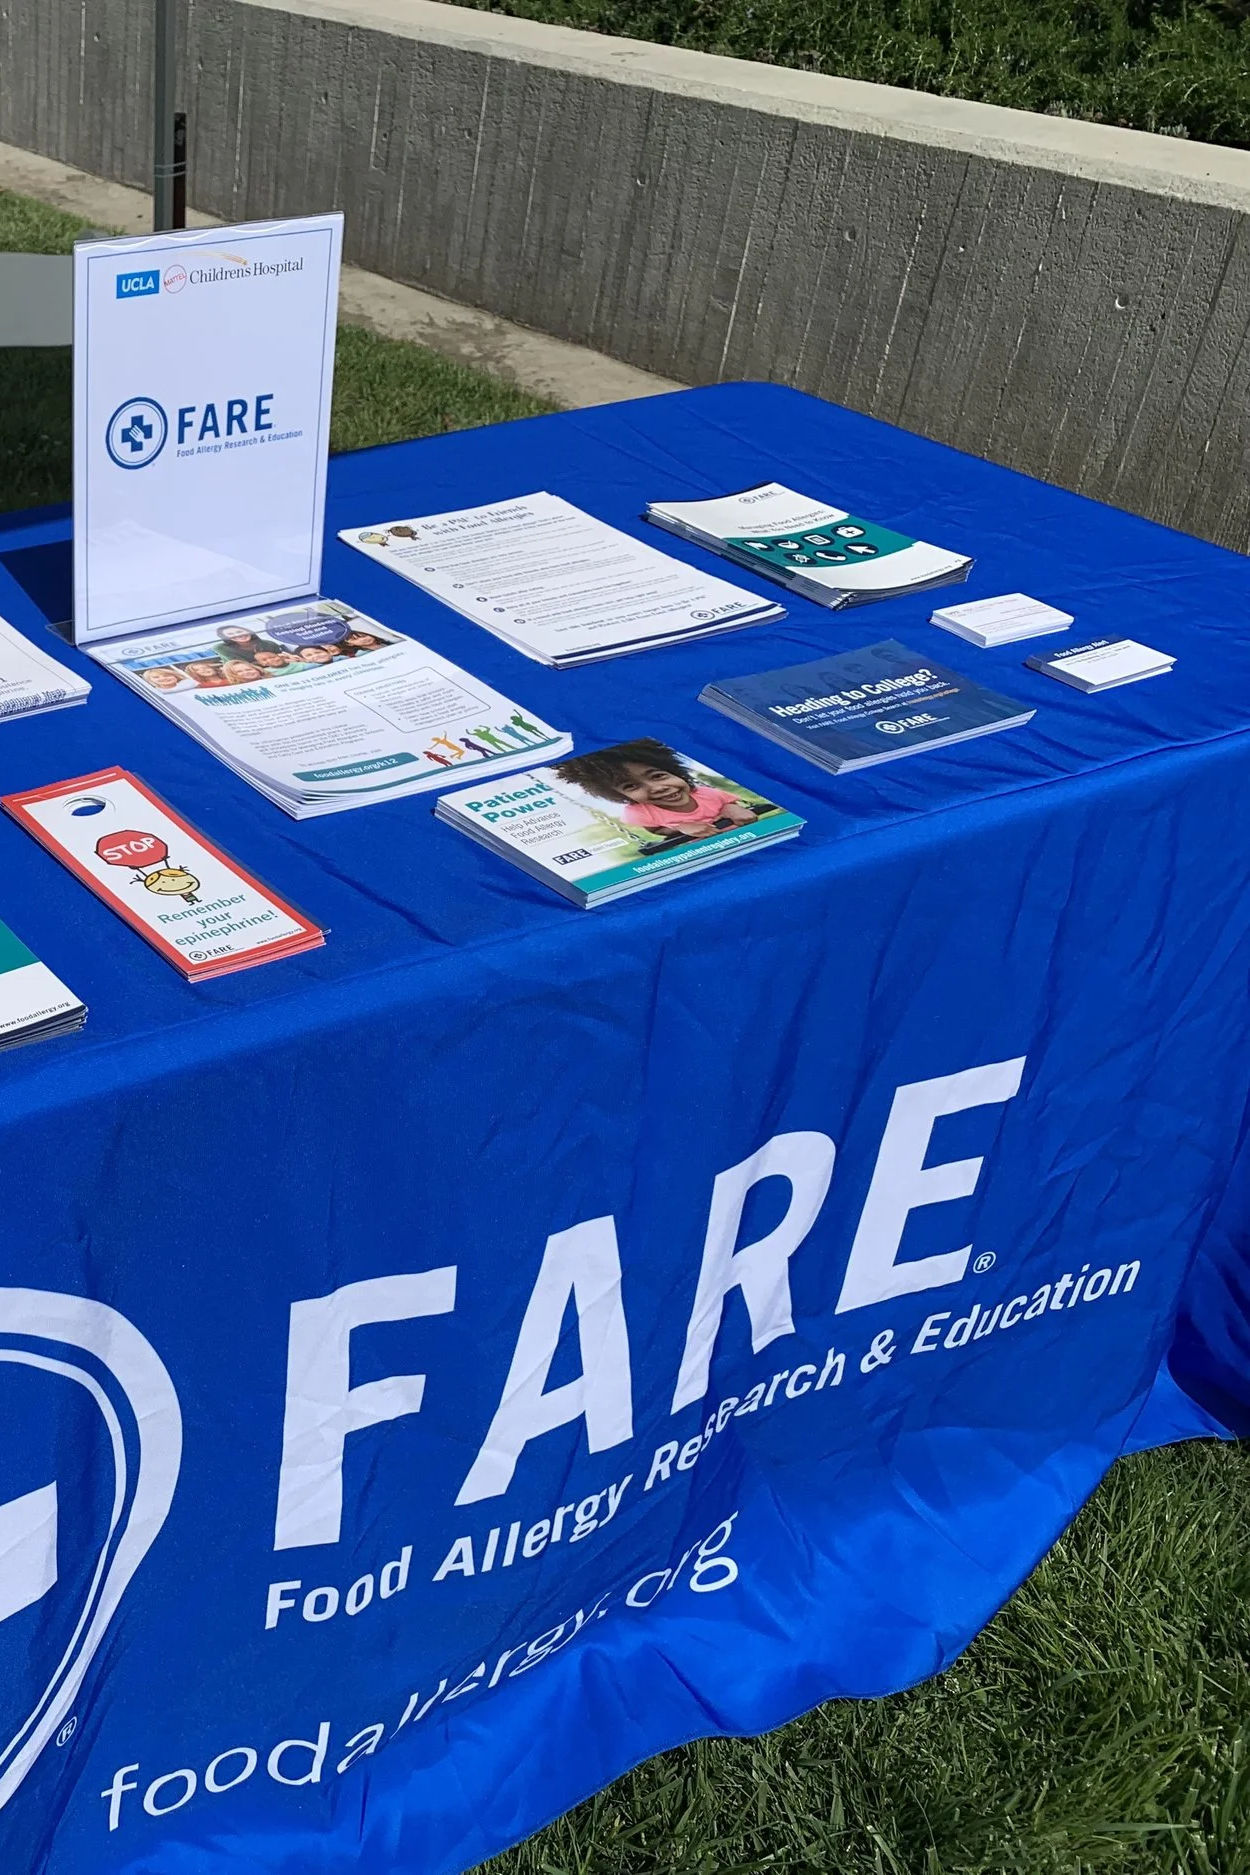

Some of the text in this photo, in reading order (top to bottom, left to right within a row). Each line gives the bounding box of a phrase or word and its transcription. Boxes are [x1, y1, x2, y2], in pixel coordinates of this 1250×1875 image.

[122, 275, 154, 292] UCLA
[254, 257, 303, 276] Hospital
[178, 393, 274, 444] FARE
[177, 448, 194, 457] Food
[197, 443, 222, 454] Allergy
[224, 437, 257, 449] Research
[268, 430, 303, 441] Education
[712, 602, 744, 614] FARE
[144, 642, 179, 652] FARE
[768, 668, 938, 717] Heading to College?
[863, 695, 897, 707] allergies
[894, 690, 915, 698] hold
[925, 681, 950, 689] back.
[897, 713, 938, 727] FARE
[313, 755, 398, 781] foodallergy.org/k12
[465, 783, 554, 812] Patient
[481, 797, 556, 823] Power
[500, 812, 560, 833] Help Advance
[511, 820, 566, 839] Food Allergy
[103, 837, 157, 861] STOP
[521, 829, 563, 846] Research
[556, 850, 589, 865] FARE
[157, 894, 246, 924] Remember
[196, 912, 232, 929] your
[175, 910, 278, 946] epinephrine!
[207, 945, 234, 956] FARE
[274, 1056, 1027, 1551] FARE
[264, 1259, 1141, 1630] Food Allergy Research & Education
[100, 1510, 740, 1832] foodallergy.org
